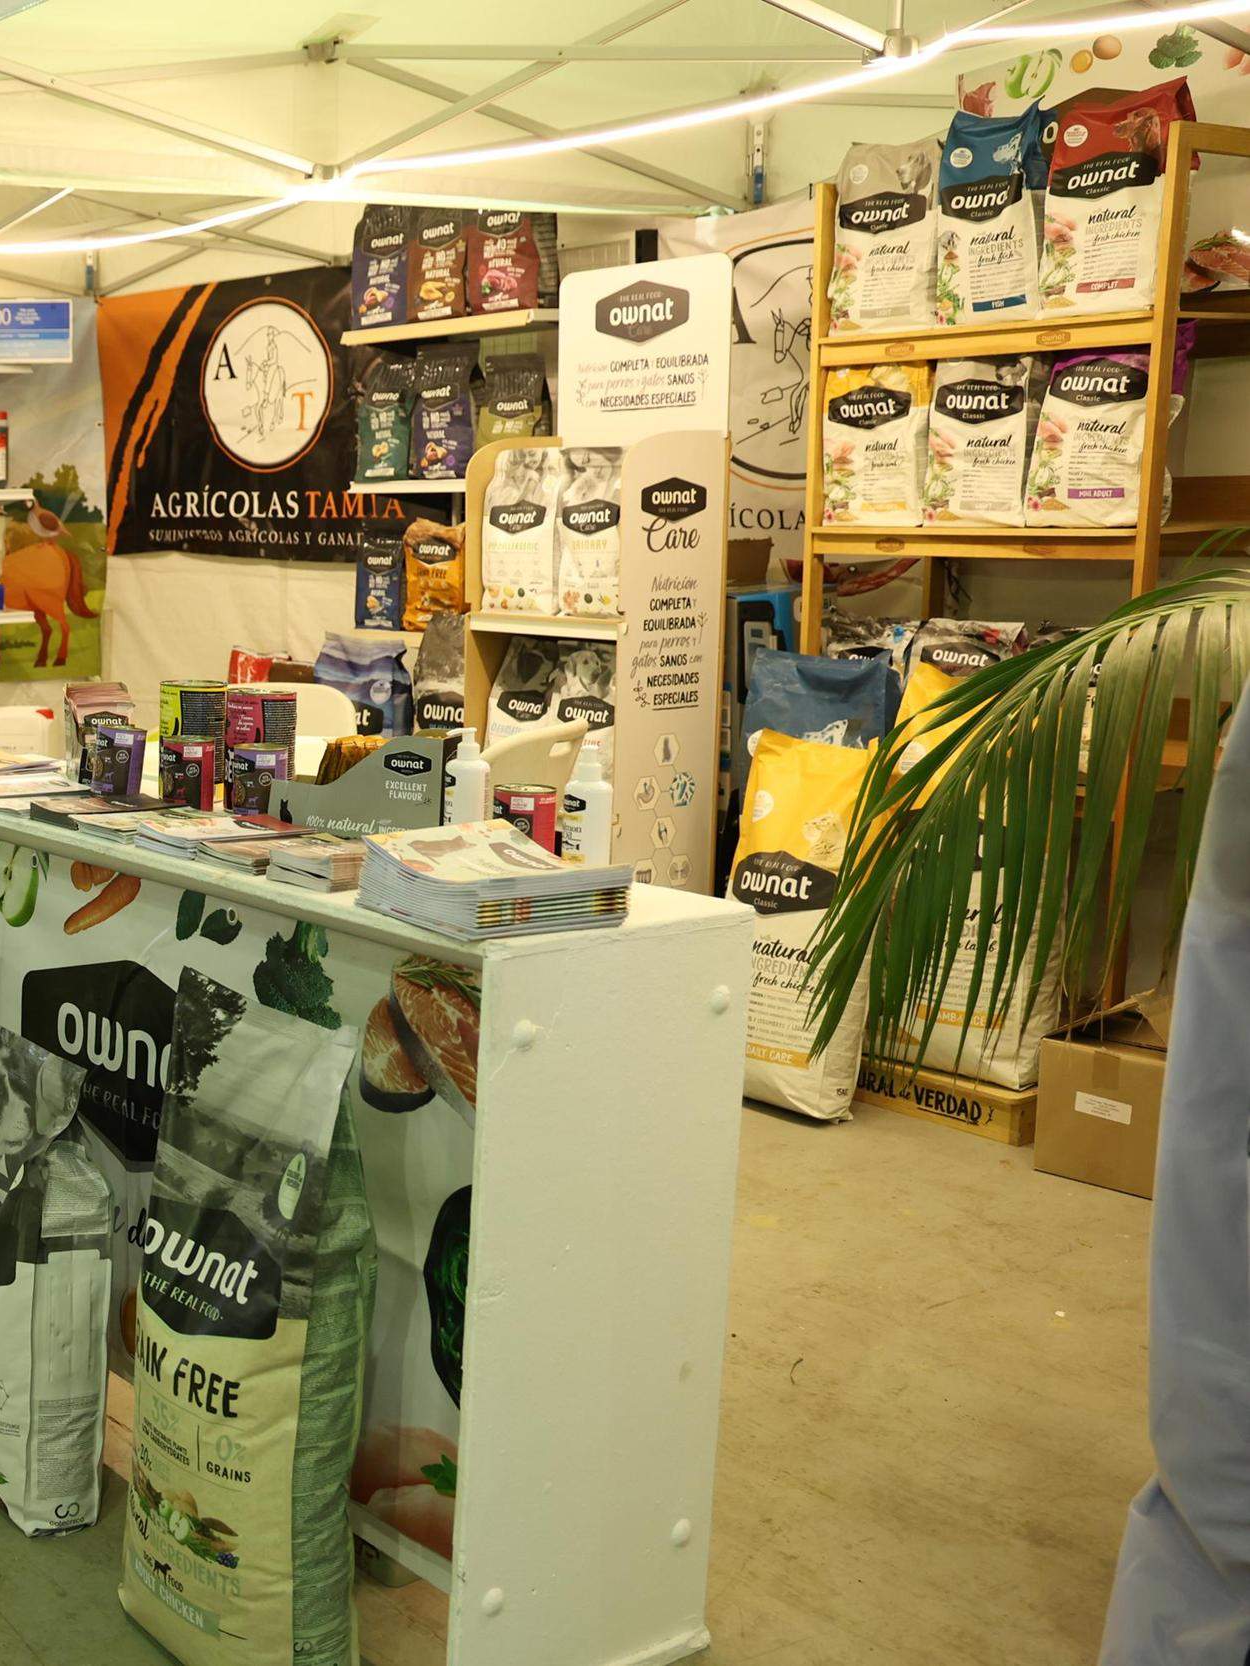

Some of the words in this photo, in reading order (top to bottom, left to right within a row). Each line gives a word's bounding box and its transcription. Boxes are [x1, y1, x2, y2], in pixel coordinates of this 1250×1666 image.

[1068, 162, 1139, 190] ownat
[851, 202, 910, 224] ownat
[1088, 205, 1136, 224] natural
[423, 222, 454, 239] ownat
[970, 226, 1015, 246] natural
[371, 233, 404, 249] ownat
[869, 241, 910, 257] natural
[609, 298, 674, 327] ownat
[214, 343, 237, 380] A
[610, 358, 649, 373] COMPLETA
[655, 353, 709, 369] EQUILIBRADA
[667, 373, 695, 386] SANOS
[1060, 376, 1130, 393] ownat
[497, 399, 528, 412] ownat
[600, 393, 649, 408] NECESIDADES
[651, 391, 697, 406] ESPECIALES
[946, 392, 1009, 411] ownat
[1076, 394, 1101, 402] Classic
[291, 392, 313, 431] T
[839, 399, 896, 419] ownat
[1076, 420, 1127, 435] natural
[865, 438, 898, 453] natural
[966, 434, 1013, 448] natural
[151, 485, 299, 519] AGRÍCOLAS
[652, 487, 697, 505] ownat
[499, 512, 537, 525] ownat
[569, 508, 611, 525] ownat
[730, 502, 805, 531] ÍCOLA
[305, 532, 311, 545] Y
[642, 517, 701, 552] Care
[419, 544, 451, 556] ownat
[367, 556, 392, 566] ownat
[651, 576, 698, 593] Nutrición
[649, 597, 692, 612] COMPLETA
[643, 616, 696, 632] EQUILIBRADA
[659, 635, 690, 654] perros
[631, 654, 657, 679] gatos
[659, 654, 688, 668] SANOS
[932, 648, 988, 668] ownat
[647, 672, 700, 688] NECESIDADES
[653, 690, 699, 706] ESPECIALES
[91, 717, 123, 726] ownat
[423, 703, 464, 723] owna
[565, 706, 609, 723] ownat
[391, 758, 424, 770] ownat
[385, 779, 428, 793] EXCELLENT
[389, 790, 423, 801] FLAVOUR
[306, 815, 326, 828] 100%
[327, 817, 376, 834] natural
[740, 871, 813, 900] ownat
[753, 897, 779, 909] Classic
[752, 939, 818, 965] natural
[752, 972, 778, 987] fresh
[58, 1002, 171, 1091] own
[83, 1080, 98, 1098] HE
[100, 1091, 138, 1122] REAL
[142, 1107, 163, 1131] FO
[899, 1083, 911, 1100] de
[913, 1085, 982, 1122] VERDAD
[144, 1218, 259, 1305] ownat
[144, 1271, 170, 1295] THE
[171, 1287, 198, 1313] REAL
[173, 1357, 240, 1418] FREE
[216, 1434, 247, 1462] 0%
[206, 1461, 251, 1483] GRAINS
[150, 1535, 241, 1597] INGREDIENTS
[168, 1574, 184, 1594] FOOD
[159, 1586, 204, 1630] CHICKEN
